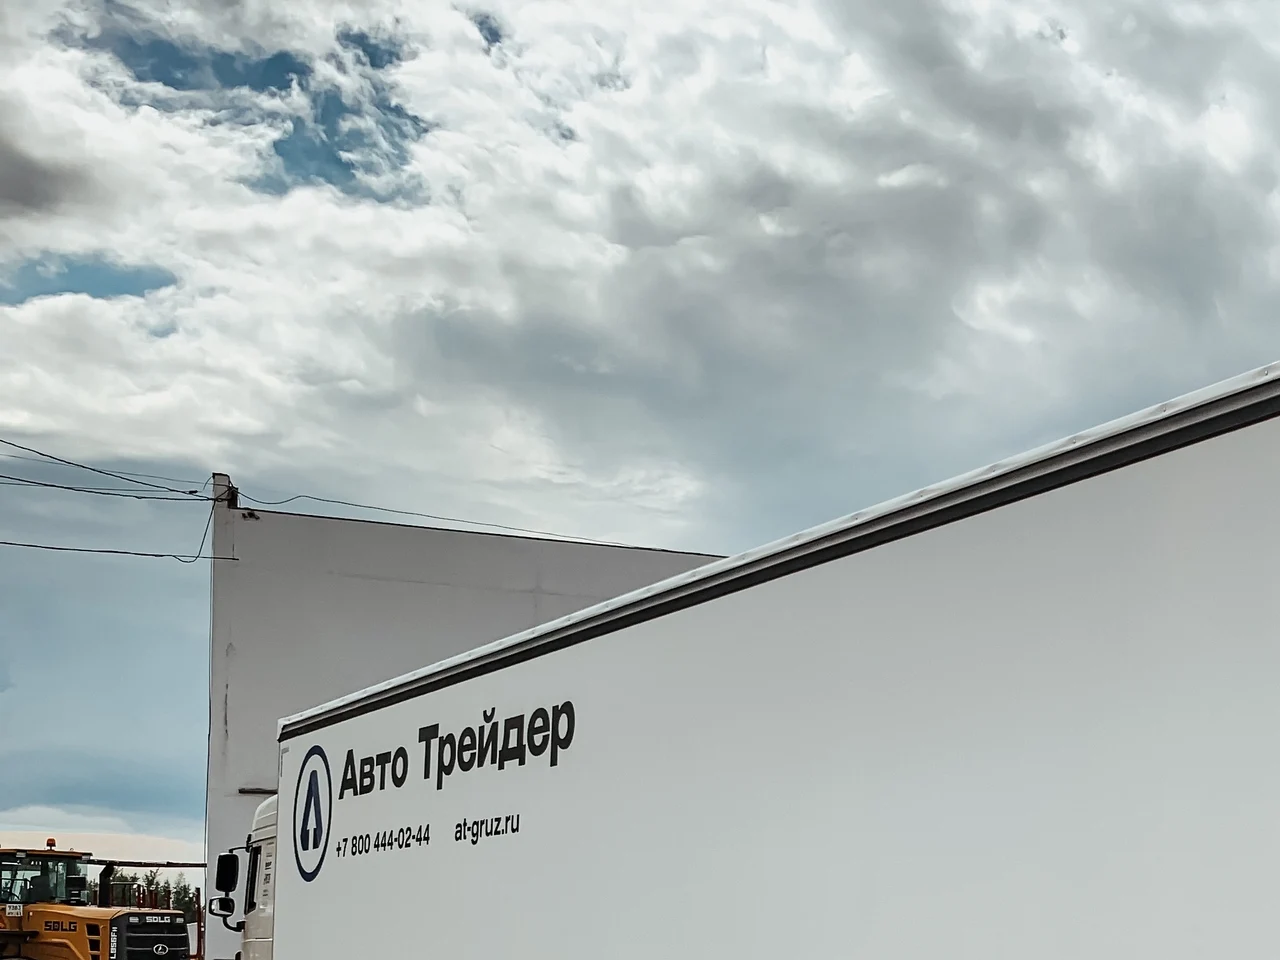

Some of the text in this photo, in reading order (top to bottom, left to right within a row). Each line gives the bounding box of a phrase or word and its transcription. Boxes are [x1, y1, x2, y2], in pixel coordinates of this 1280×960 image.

[337, 700, 576, 800] Авто Трейдер
[335, 823, 431, 858] +7 800 444-02-44
[454, 813, 521, 846] at-gruz.ru
[44, 920, 78, 932] SDLG
